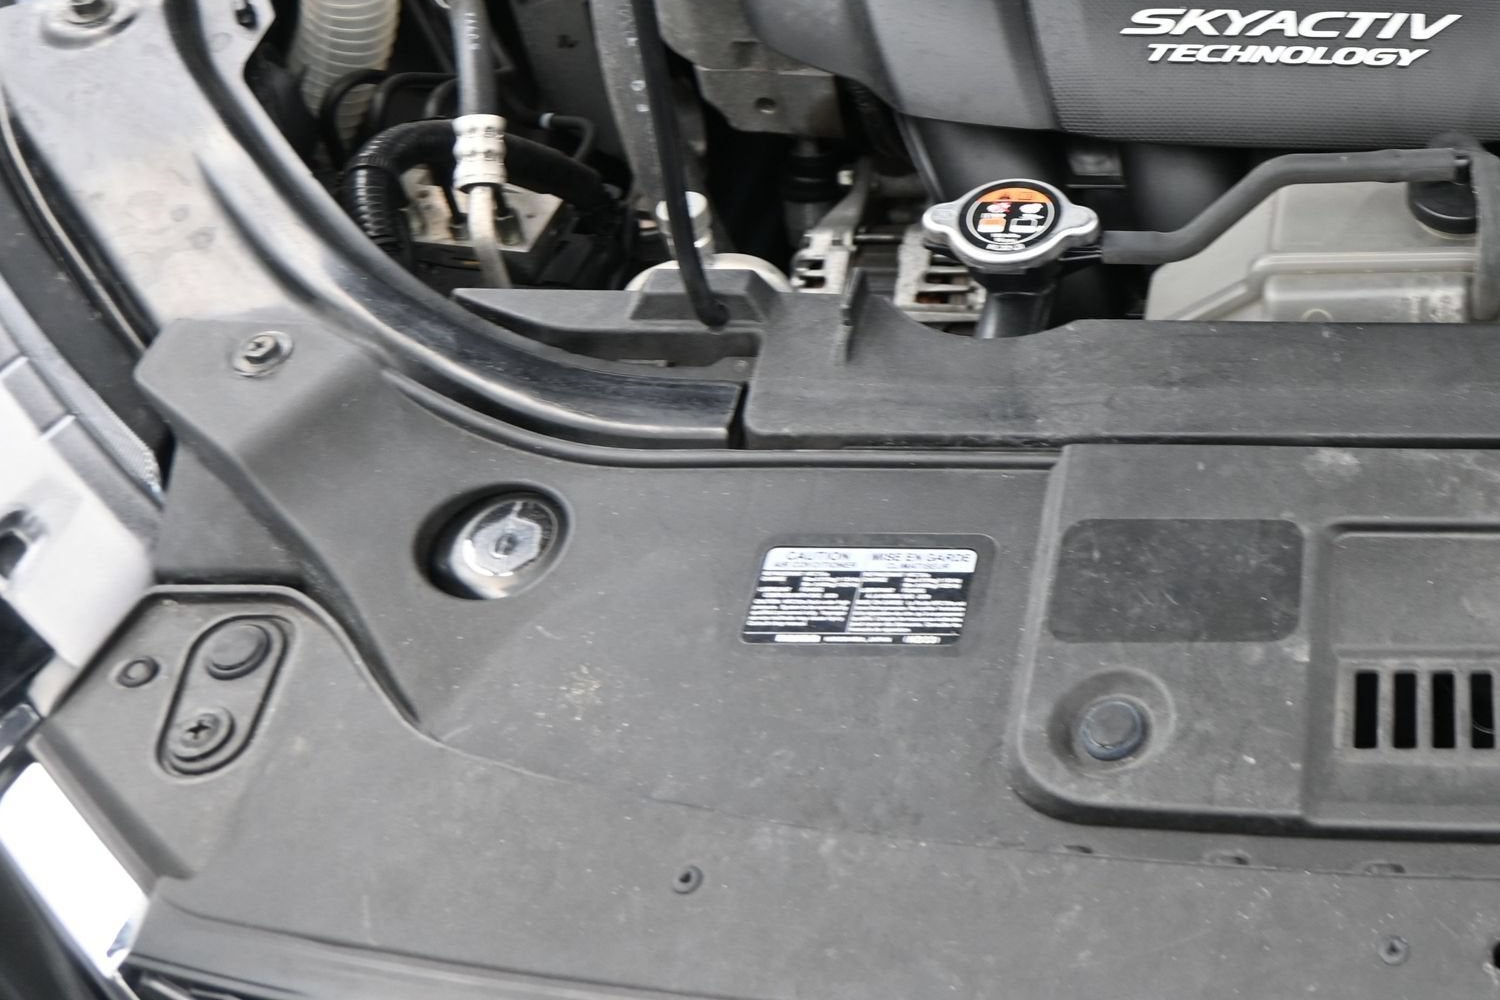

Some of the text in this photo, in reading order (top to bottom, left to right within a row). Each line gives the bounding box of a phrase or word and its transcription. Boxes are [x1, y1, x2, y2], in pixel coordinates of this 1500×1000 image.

[1119, 7, 1463, 41] SKYACTIV
[1147, 43, 1431, 67] TECHNOLOGY
[785, 551, 850, 562] CAUTION
[871, 552, 971, 563] MISE EN GARDE
